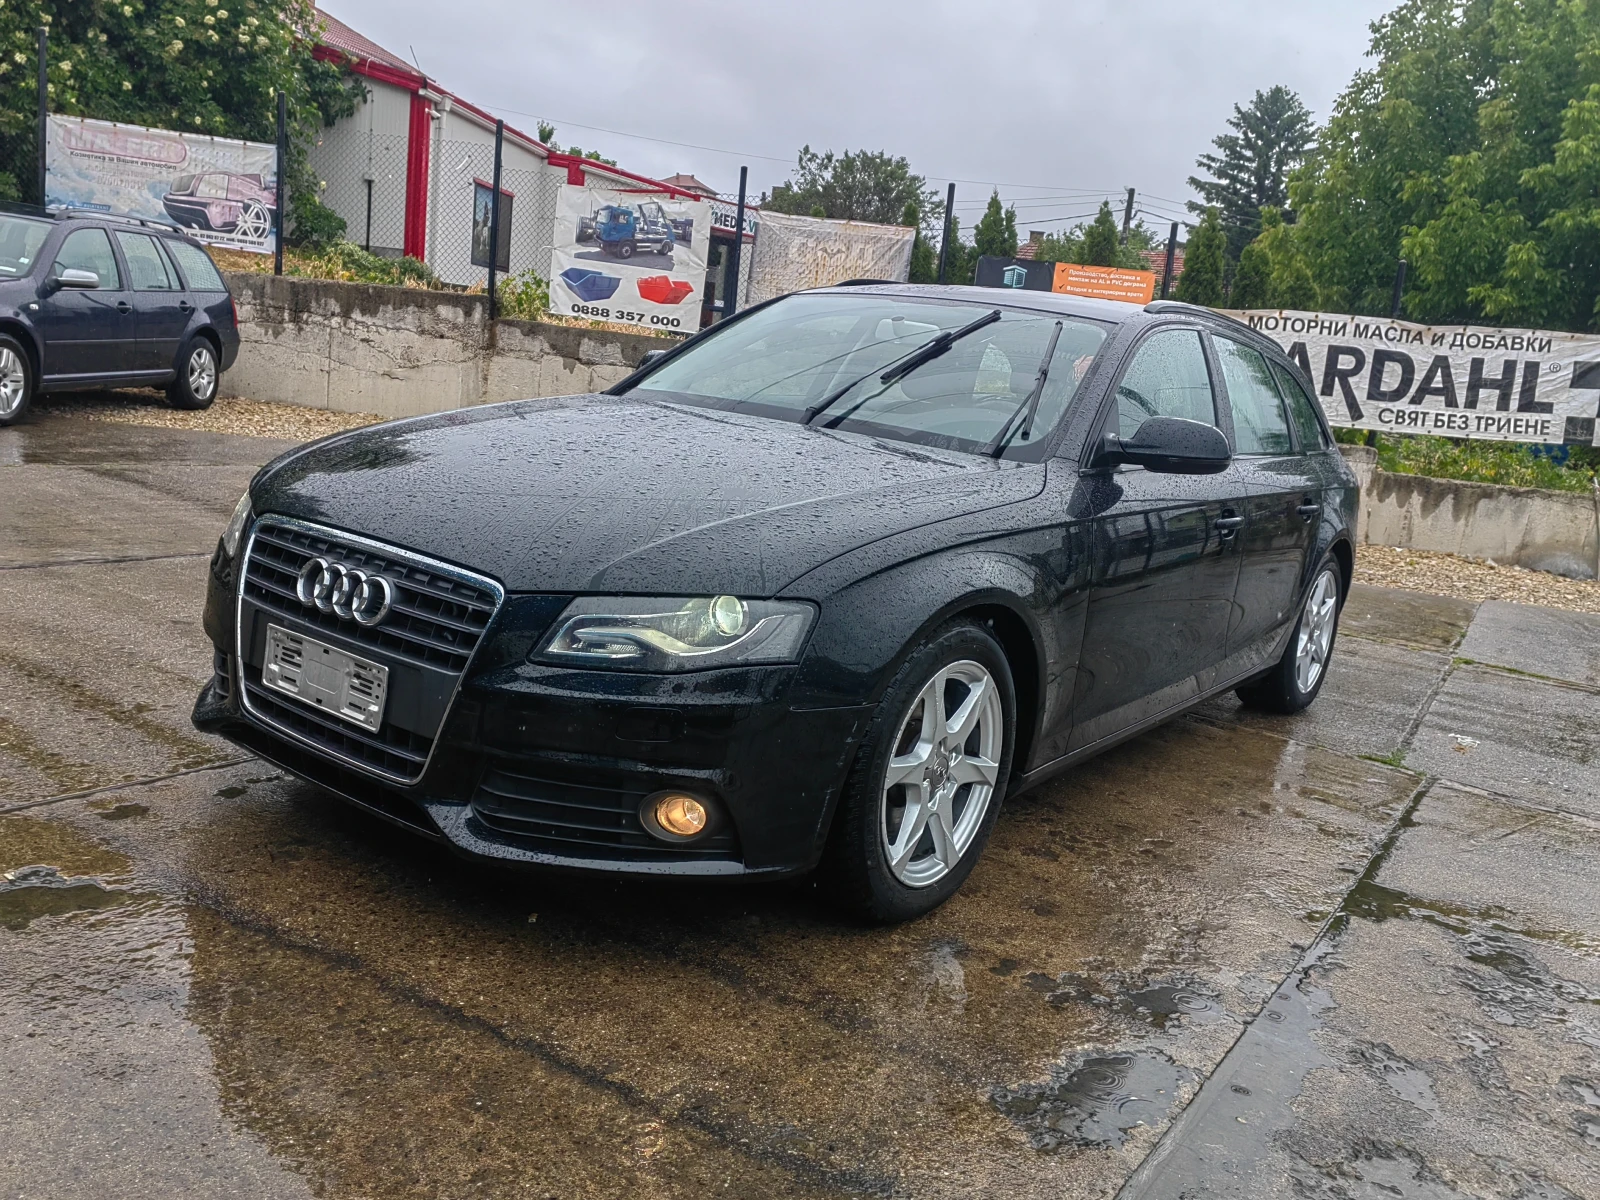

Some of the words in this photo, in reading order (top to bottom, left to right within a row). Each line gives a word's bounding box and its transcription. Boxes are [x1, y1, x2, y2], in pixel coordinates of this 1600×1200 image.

[140, 160, 177, 170] автомобил
[571, 303, 610, 317] 0888
[615, 310, 645, 322] 357
[650, 315, 680, 327] 000
[1248, 315, 1347, 336] МОТОРНИ
[1353, 323, 1424, 345] МАСЛА
[1430, 332, 1445, 347] И
[1449, 332, 1552, 353] ДОБАВКИ
[1378, 408, 1430, 427] СВЯТ
[1433, 412, 1469, 430] БЕЗ
[1475, 416, 1551, 436] ТРИЕНЕ
